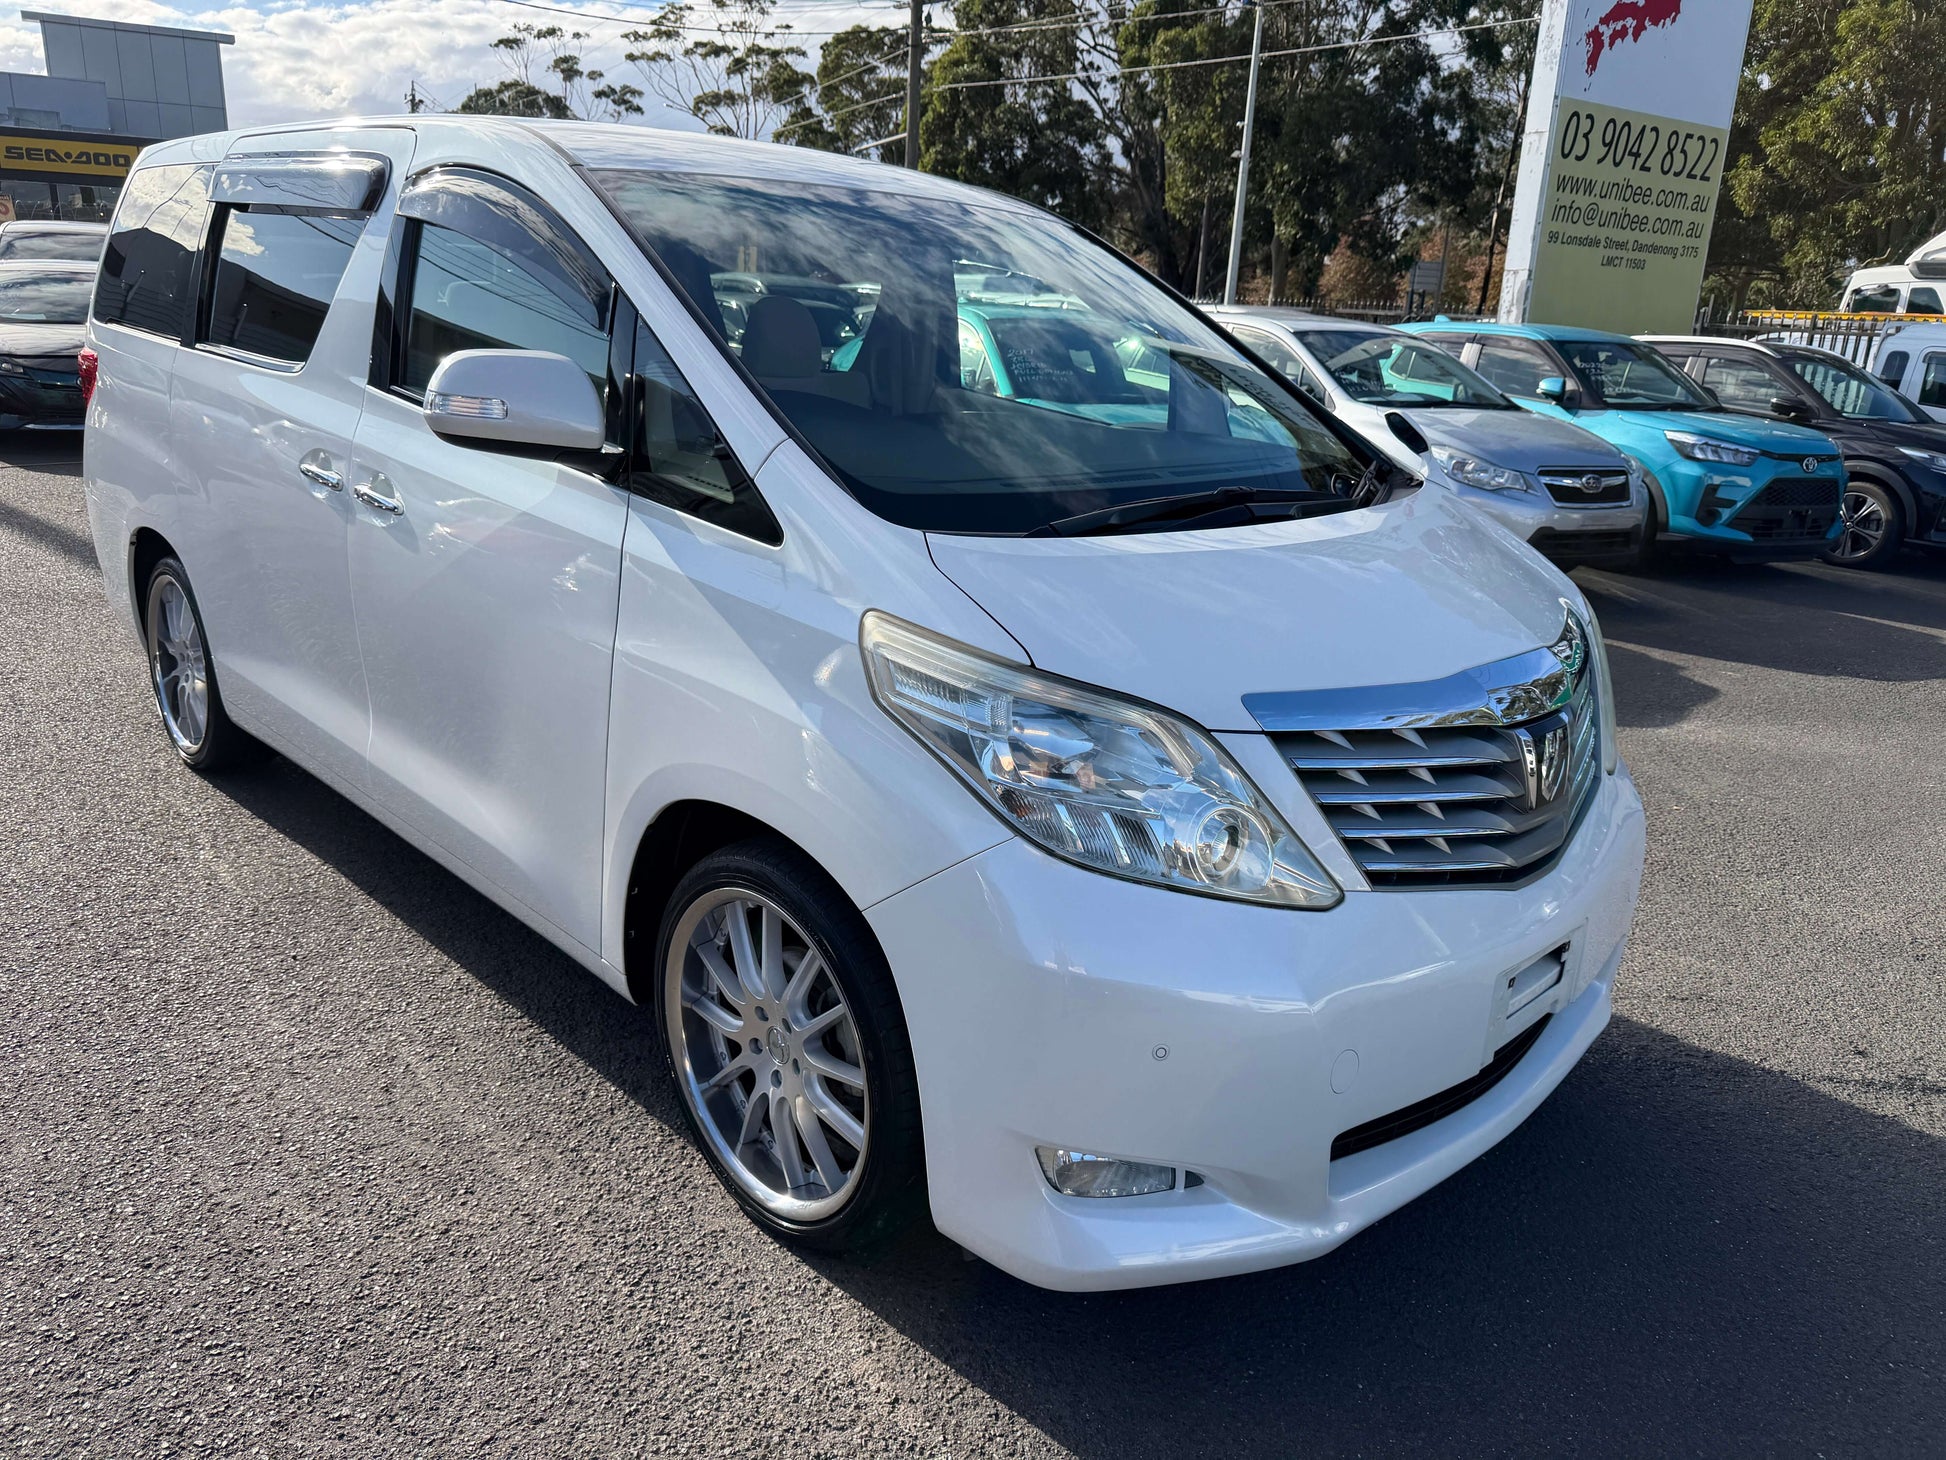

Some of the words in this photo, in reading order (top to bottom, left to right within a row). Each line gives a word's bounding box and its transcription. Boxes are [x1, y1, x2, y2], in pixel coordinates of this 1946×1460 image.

[1561, 111, 1595, 162] 03
[1596, 117, 1660, 173] 9042
[1660, 130, 1719, 182] 8522
[1556, 173, 1711, 213] www.unibee.com.au
[1551, 199, 1704, 240] info@unibee.com.au
[1547, 231, 1560, 244] 99
[1560, 232, 1601, 249] Lonsdale
[1602, 236, 1631, 253] Street,
[1631, 240, 1679, 259] Dandenong
[1680, 245, 1699, 259] 3175
[1600, 255, 1625, 269] LMCT
[1625, 257, 1647, 271] 11503
